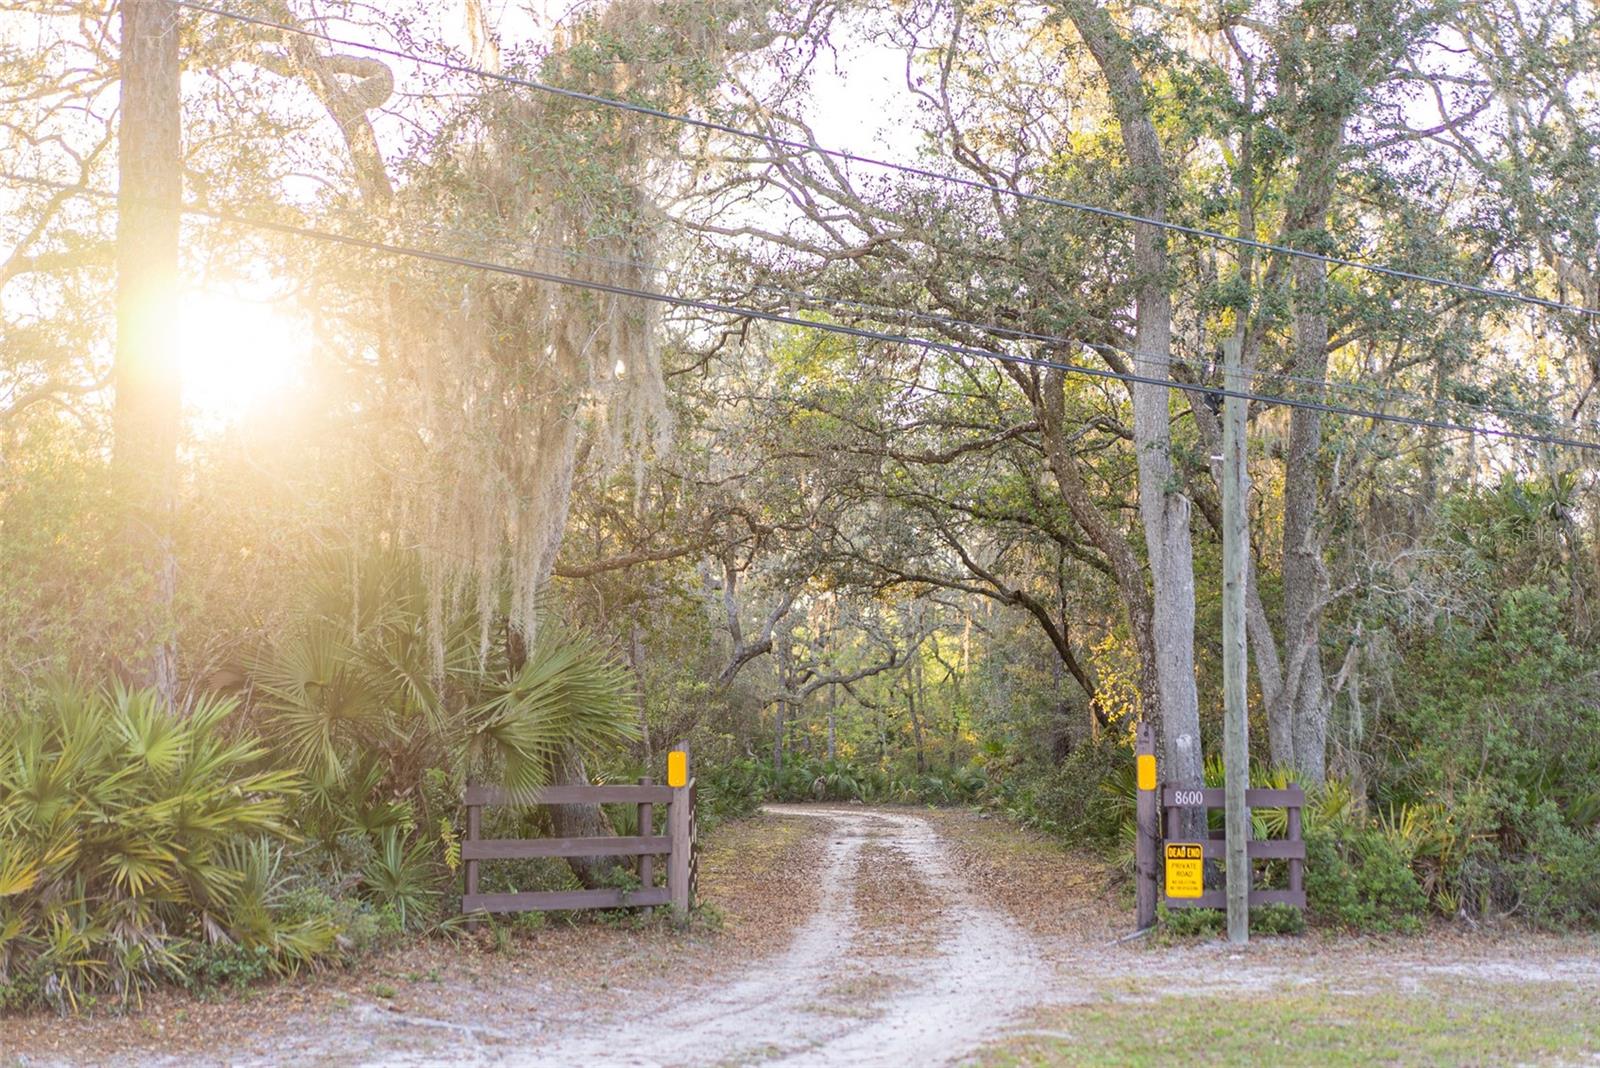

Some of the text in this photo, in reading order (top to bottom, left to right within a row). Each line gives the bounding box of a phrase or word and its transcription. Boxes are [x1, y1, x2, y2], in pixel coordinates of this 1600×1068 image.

[1175, 790, 1203, 805] 8600
[1168, 846, 1200, 858] DEAD END
